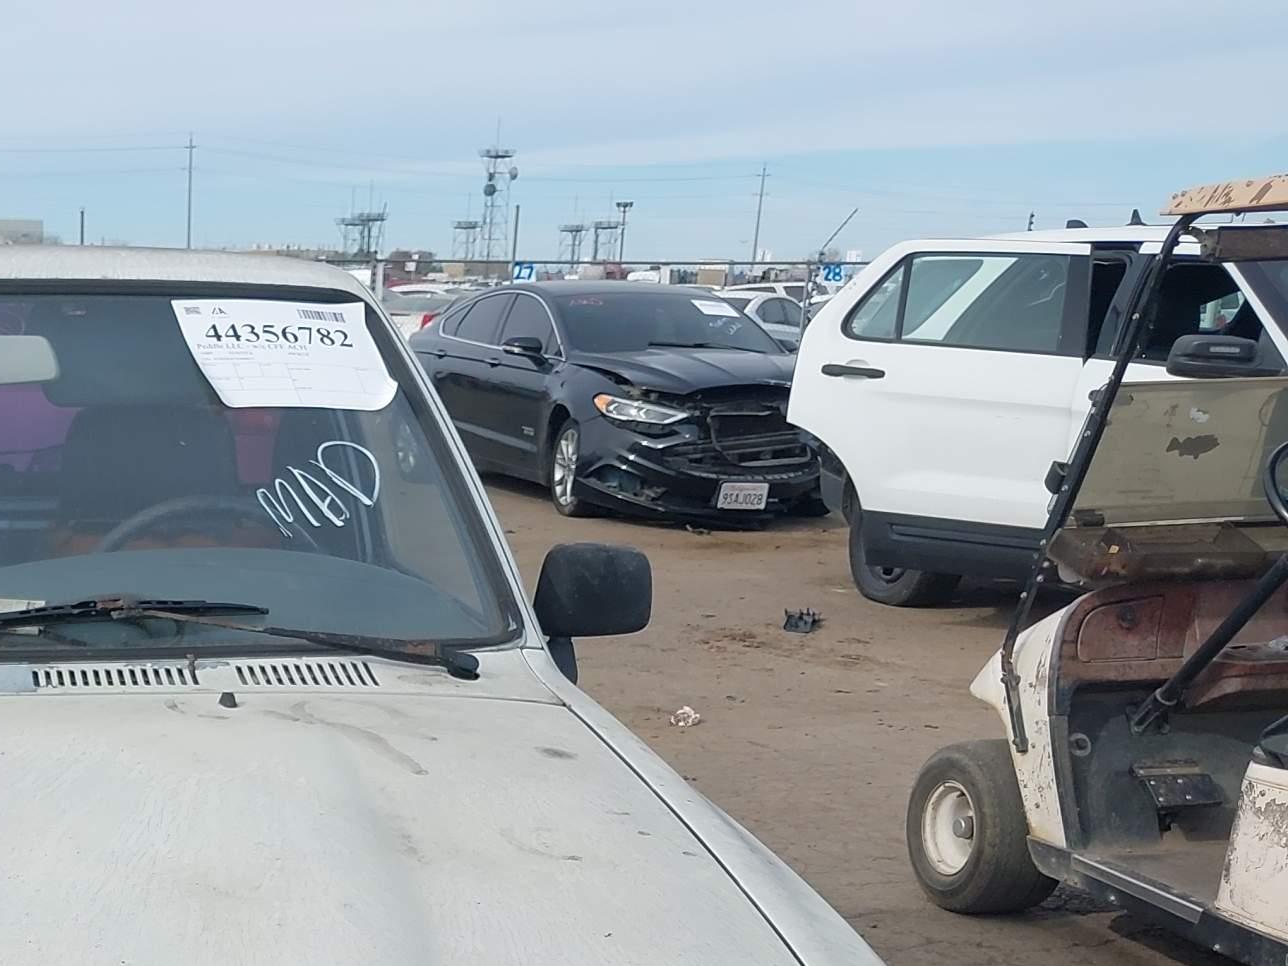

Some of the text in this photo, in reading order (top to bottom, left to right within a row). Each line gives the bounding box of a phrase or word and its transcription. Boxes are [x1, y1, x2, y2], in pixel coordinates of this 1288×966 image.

[513, 261, 534, 280] 27
[823, 263, 842, 283] 28
[205, 323, 353, 348] 44356782
